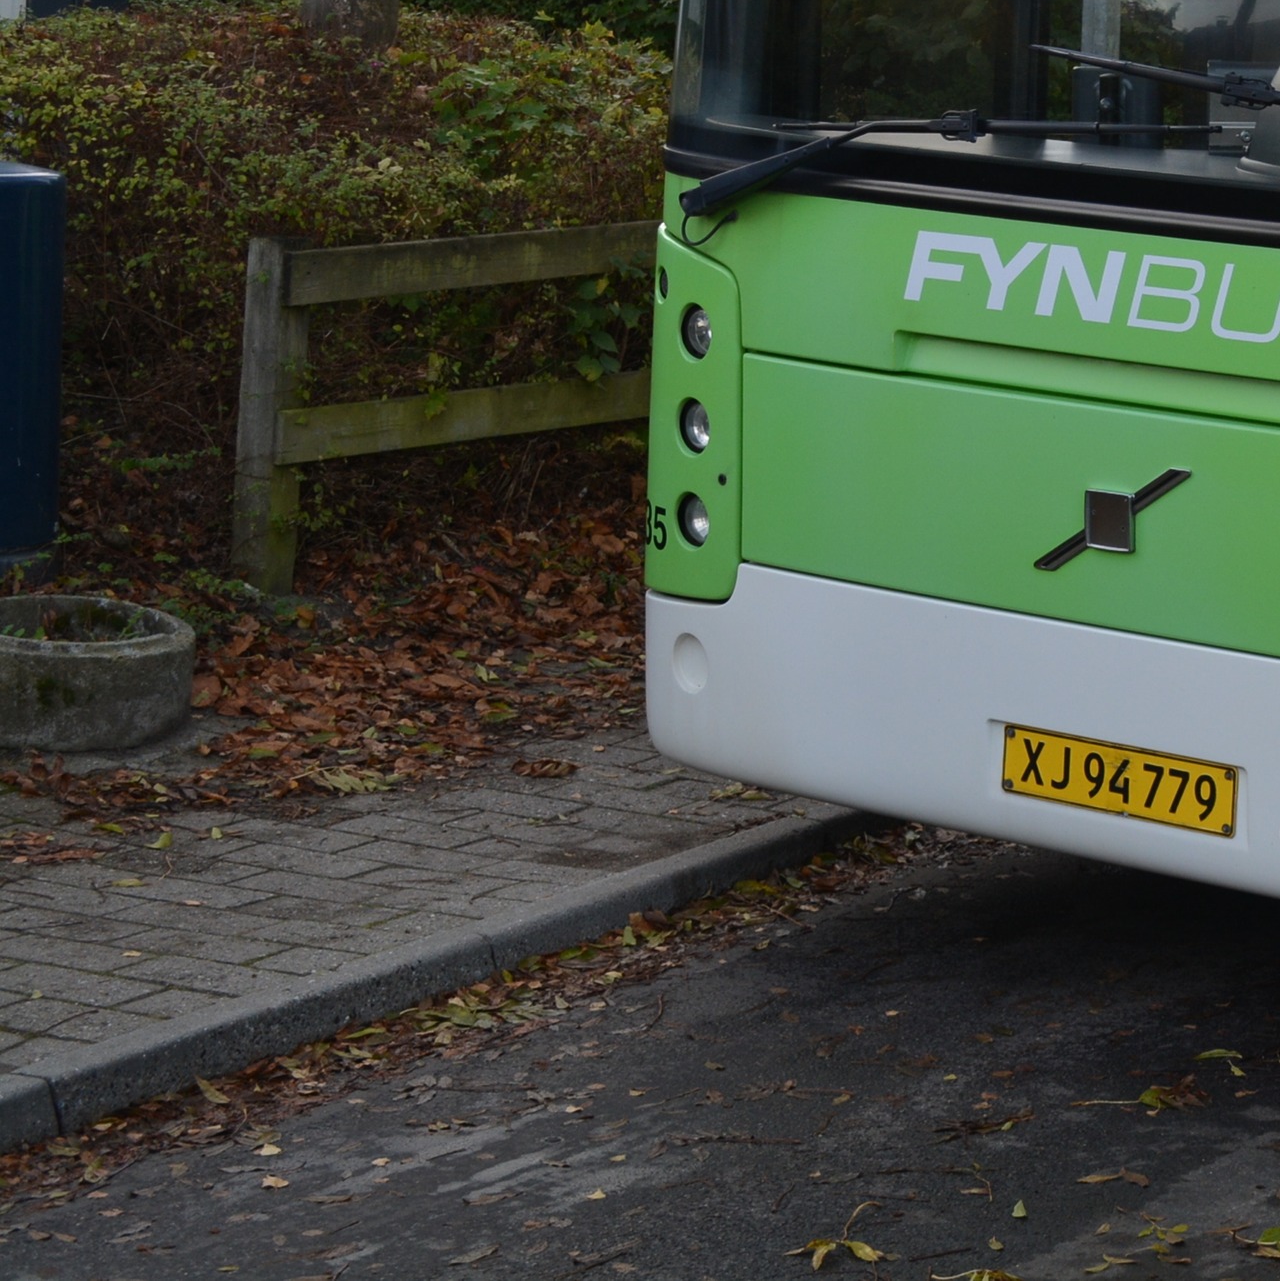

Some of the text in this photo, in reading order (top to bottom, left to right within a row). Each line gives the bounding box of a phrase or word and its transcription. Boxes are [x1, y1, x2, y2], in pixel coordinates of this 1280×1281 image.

[1021, 738, 1217, 822] XJ 94 779
